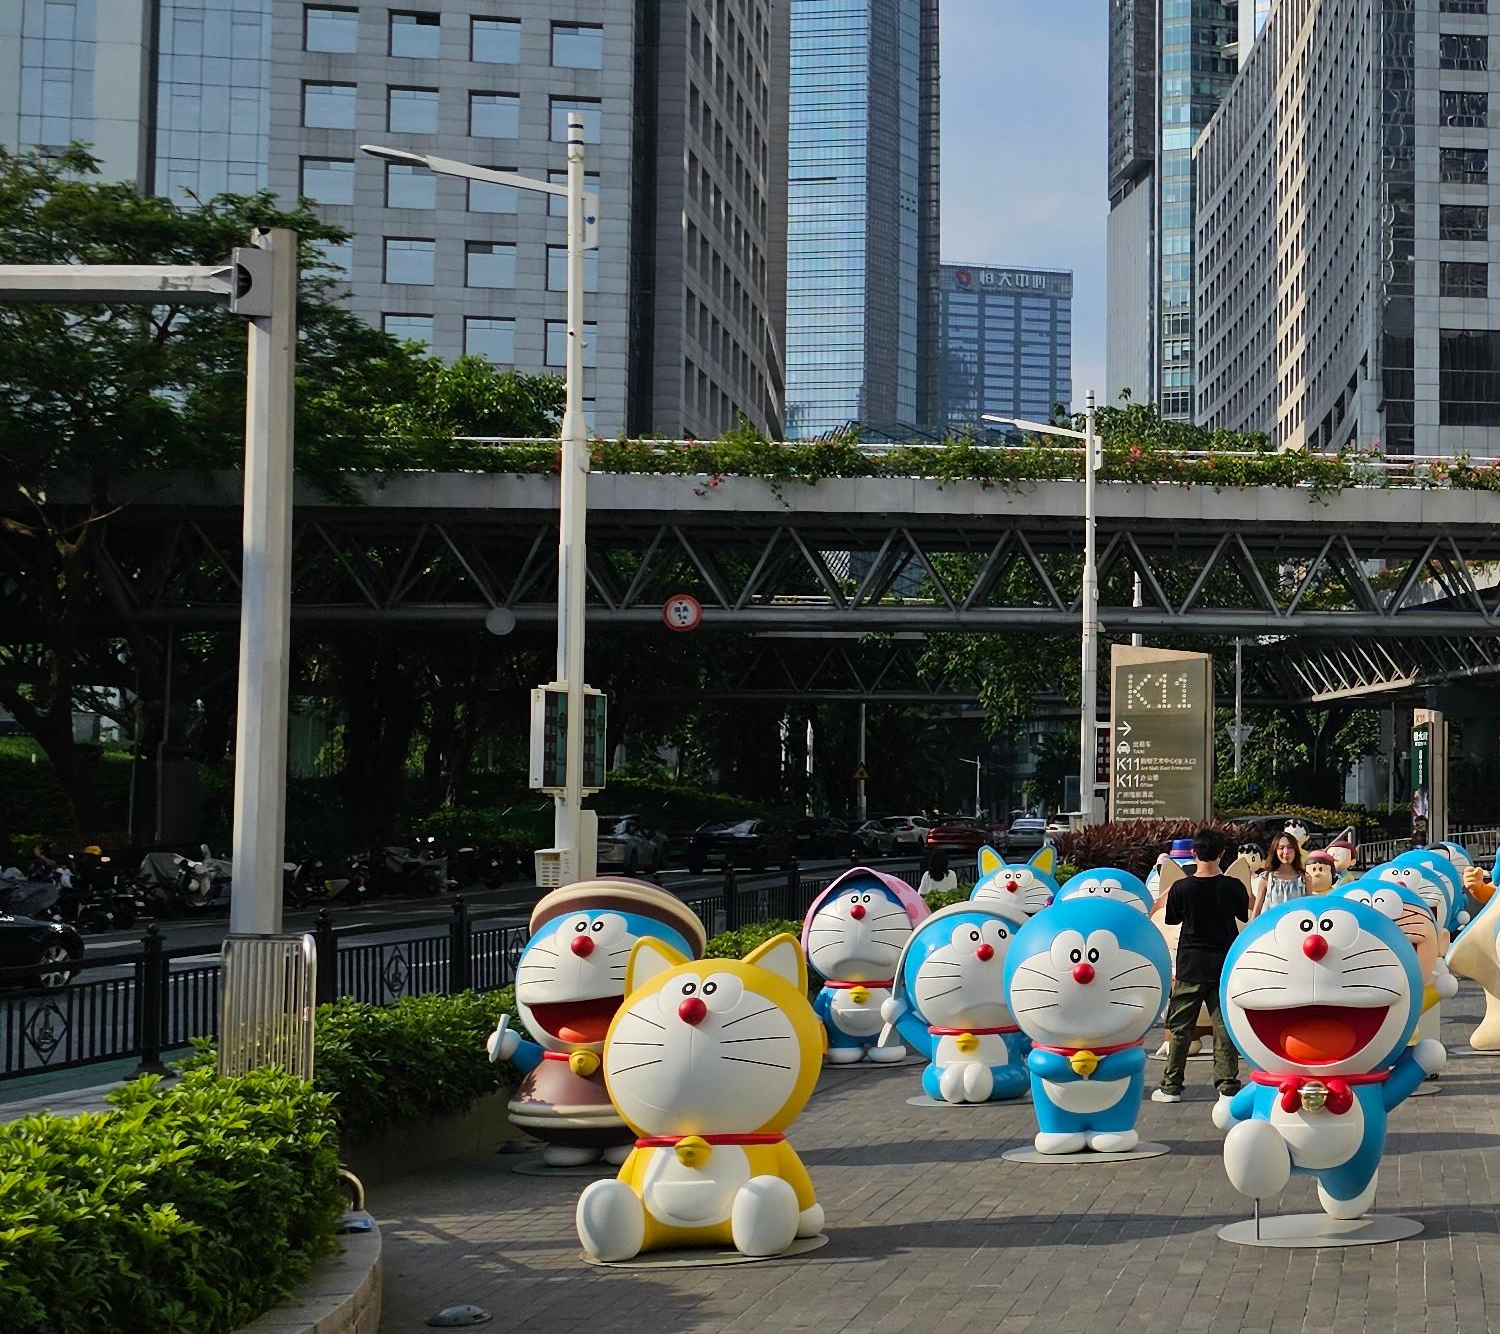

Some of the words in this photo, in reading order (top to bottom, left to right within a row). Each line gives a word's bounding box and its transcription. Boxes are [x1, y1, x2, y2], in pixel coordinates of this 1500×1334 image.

[980, 270, 1046, 289] 恒大中心
[1127, 673, 1192, 709] K11
[1116, 757, 1140, 771] K11
[1116, 773, 1140, 788] K11
